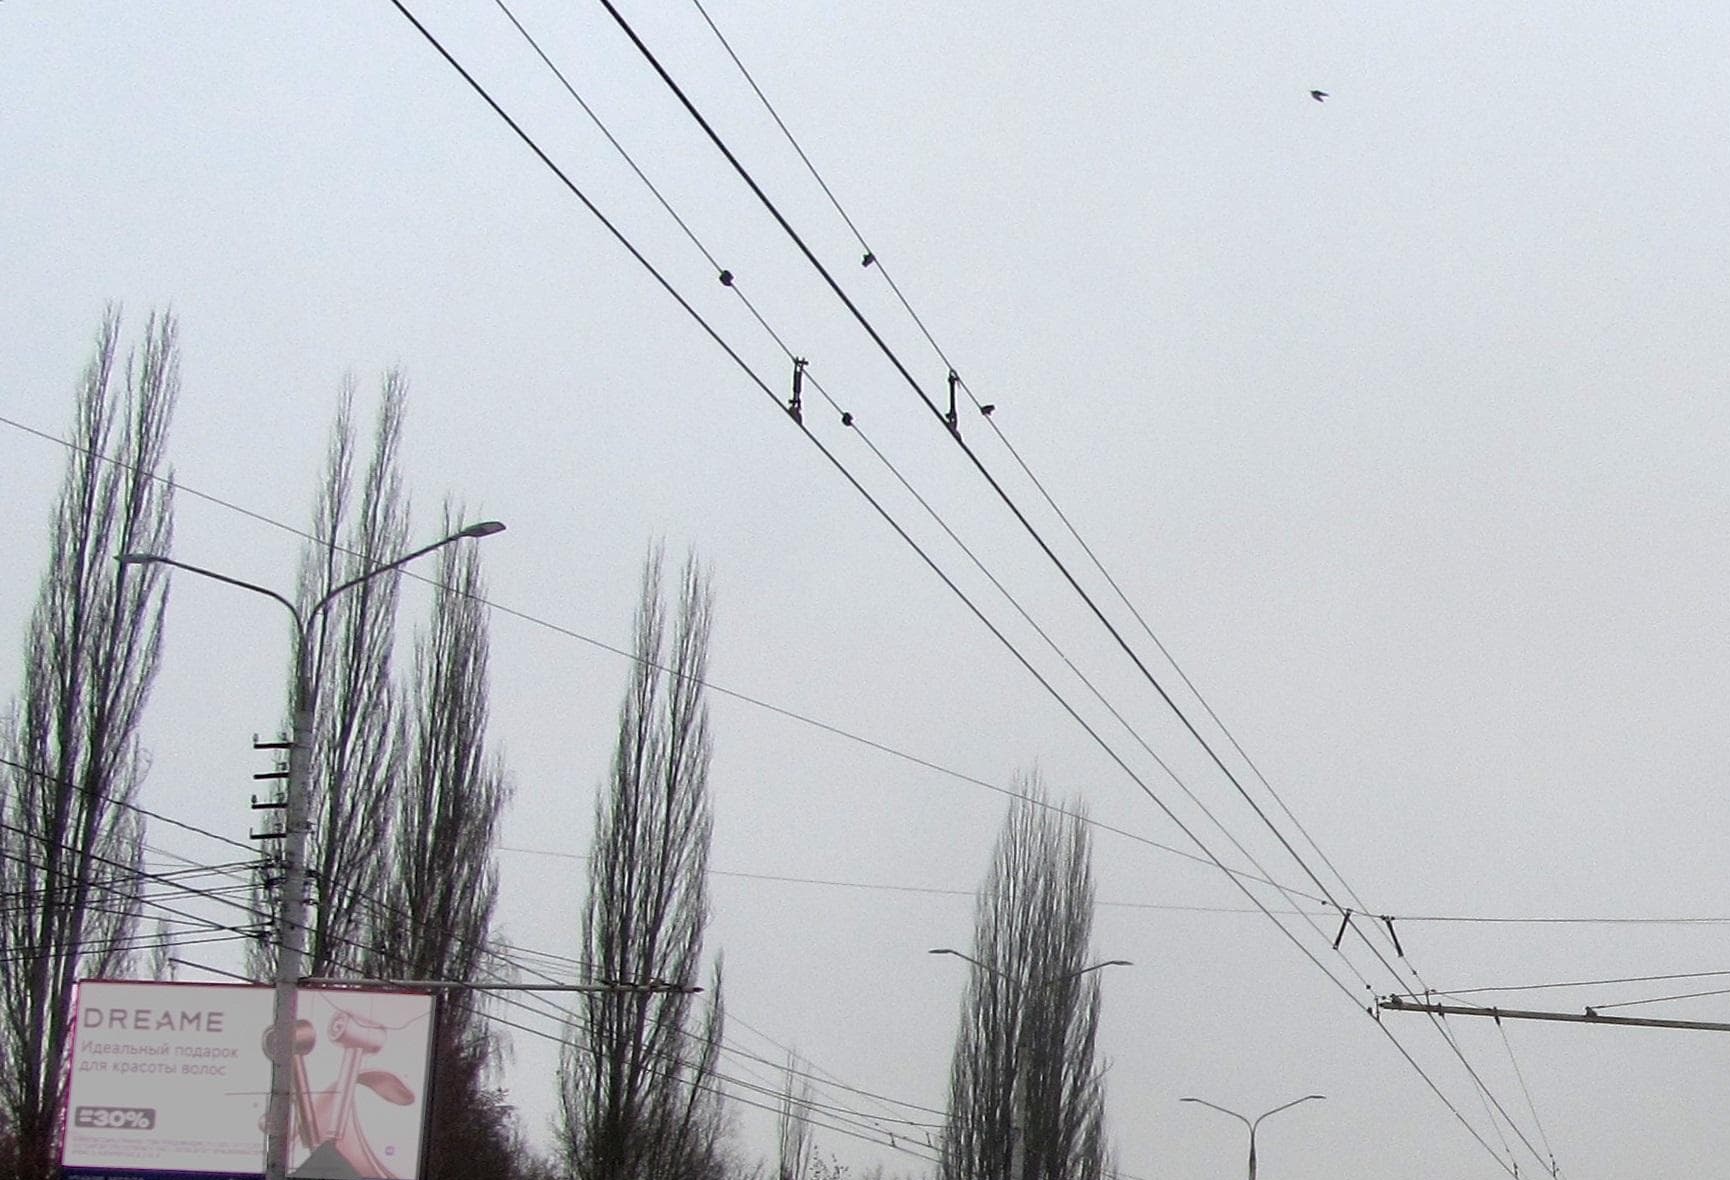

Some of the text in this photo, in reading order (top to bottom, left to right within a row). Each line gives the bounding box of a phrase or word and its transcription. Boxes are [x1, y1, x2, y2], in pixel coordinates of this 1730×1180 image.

[83, 1007, 224, 1032] DREAME
[81, 1040, 239, 1060] Идеальный подарок
[79, 1060, 227, 1076] для красоты волос
